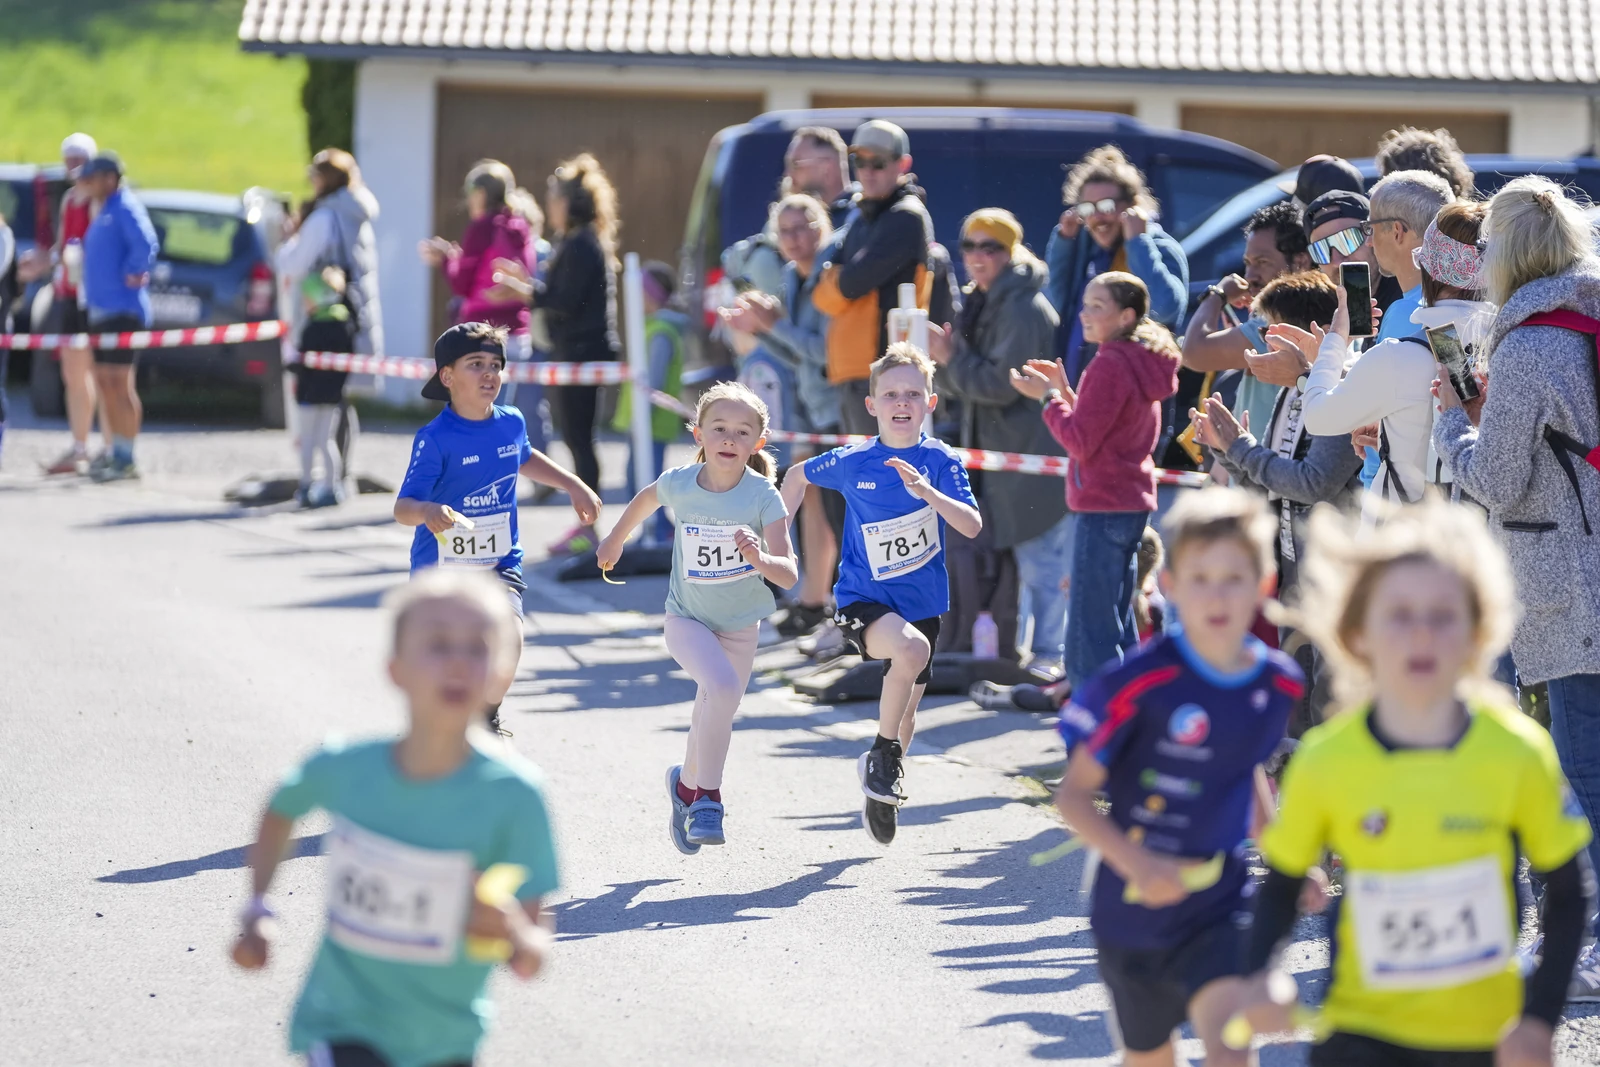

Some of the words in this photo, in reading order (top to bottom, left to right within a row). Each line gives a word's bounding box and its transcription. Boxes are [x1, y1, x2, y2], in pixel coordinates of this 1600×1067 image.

[462, 455, 480, 465] JAKO
[856, 481, 876, 490] JAKO
[453, 533, 496, 555] 81-1
[879, 527, 928, 561] 78-1
[697, 545, 744, 567] 51-1
[714, 567, 747, 577] Voralpencup
